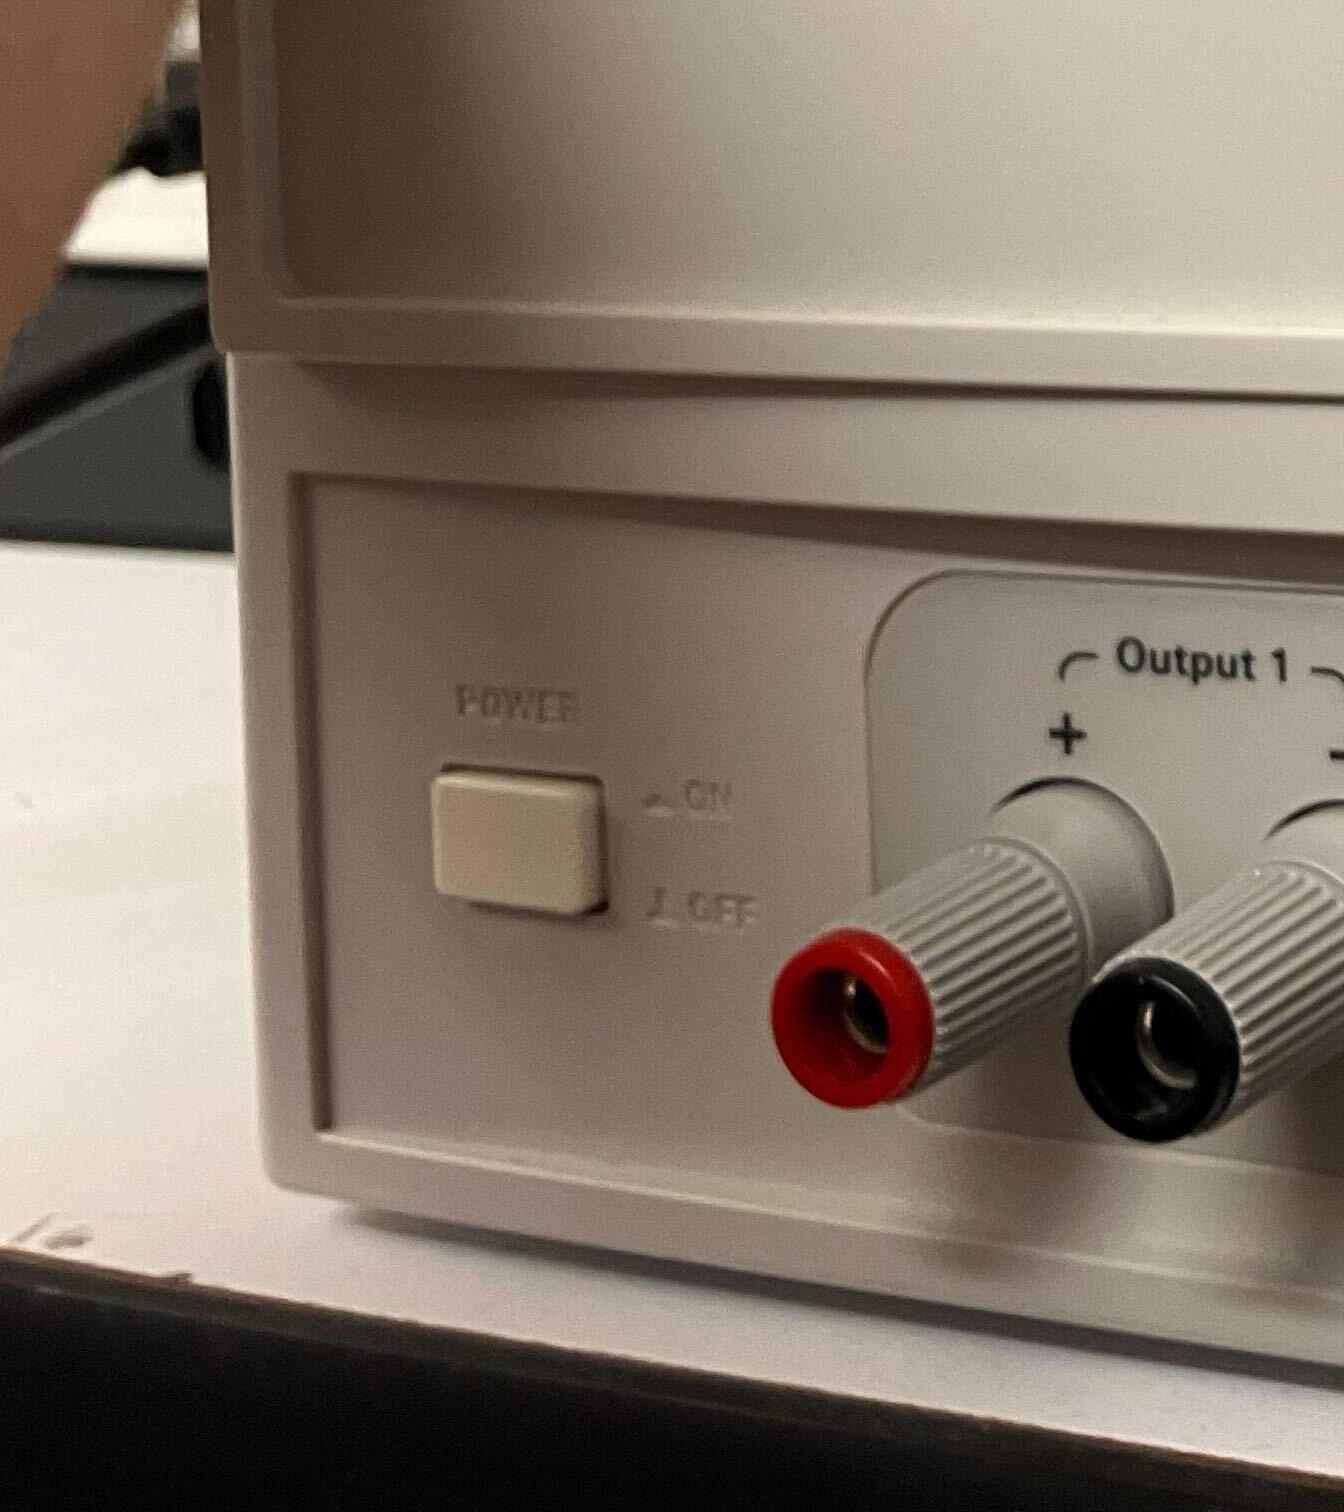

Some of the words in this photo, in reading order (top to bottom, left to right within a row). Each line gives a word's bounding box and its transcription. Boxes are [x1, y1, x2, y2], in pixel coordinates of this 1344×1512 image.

[1116, 635, 1256, 687] Output
[1270, 647, 1288, 683] 1
[454, 683, 582, 726] POWER
[682, 779, 732, 819] ON
[686, 891, 757, 930] OFF
